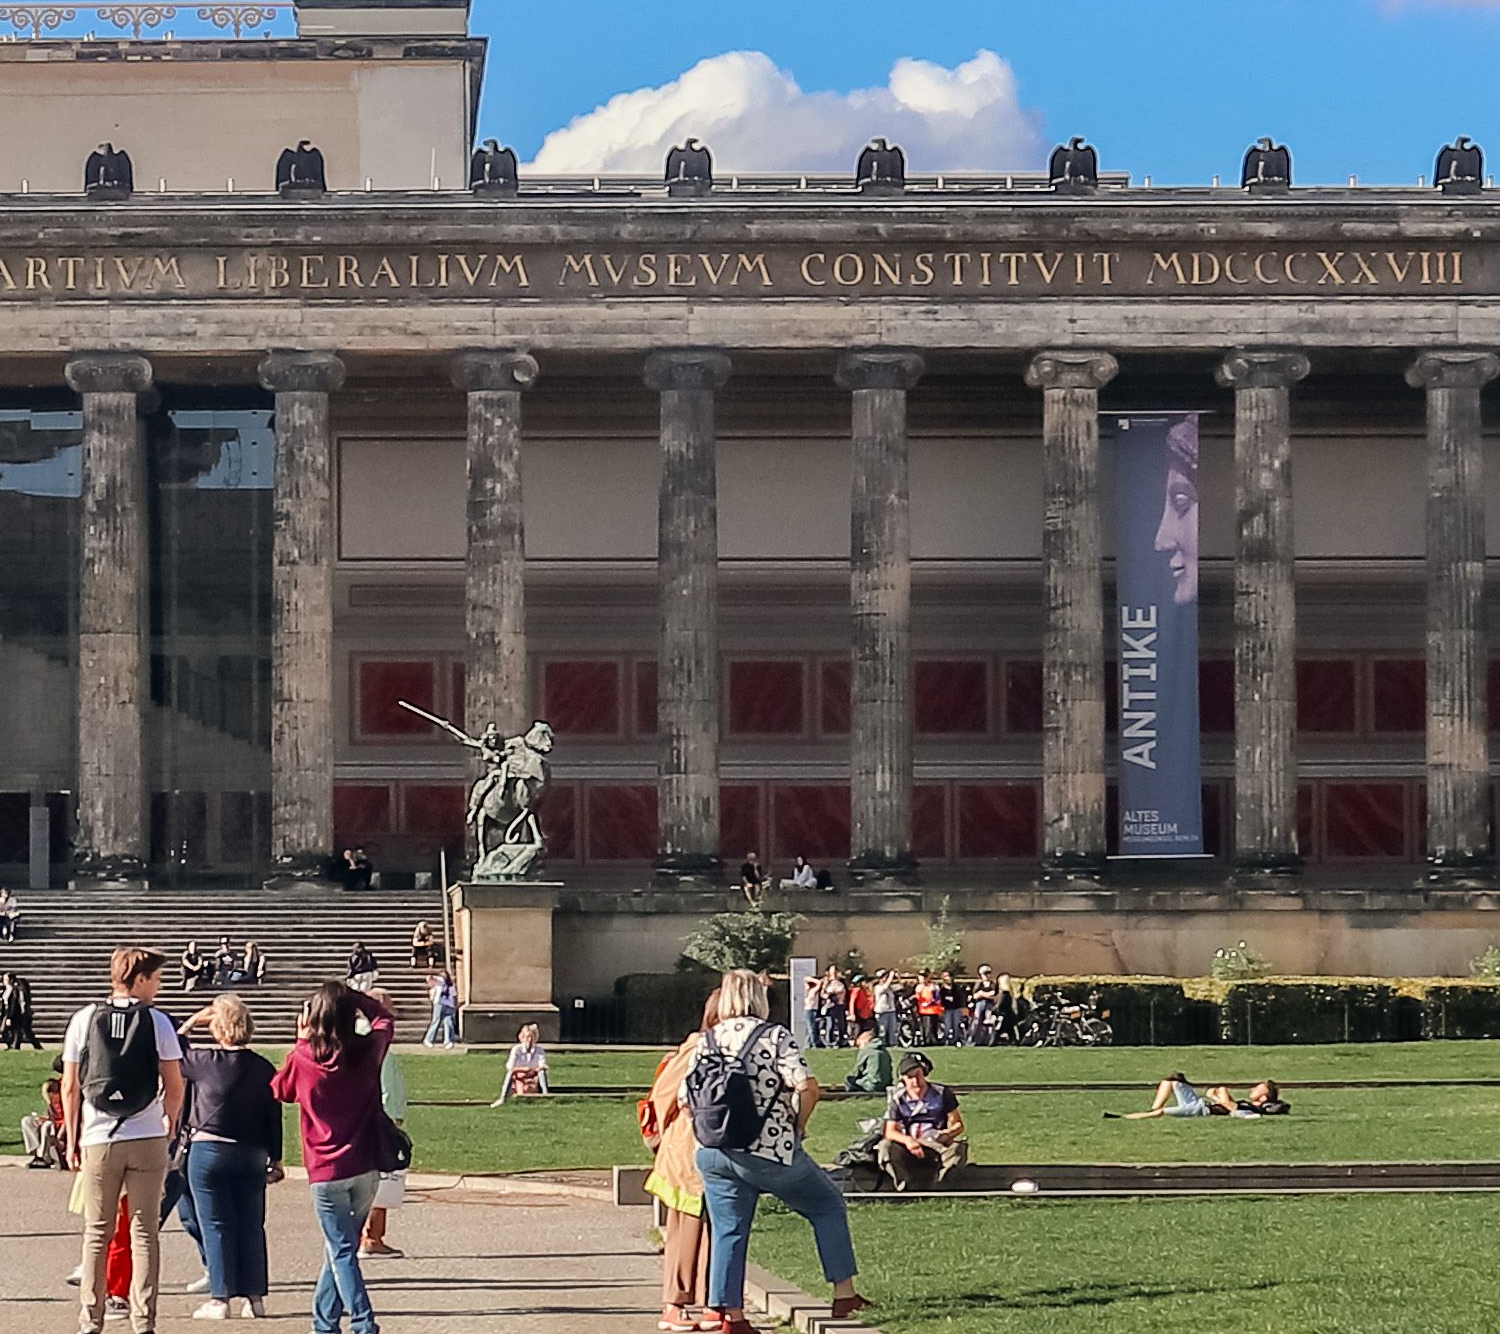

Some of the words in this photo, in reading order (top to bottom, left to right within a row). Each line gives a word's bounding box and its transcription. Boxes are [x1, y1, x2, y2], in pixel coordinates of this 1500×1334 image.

[215, 253, 531, 290] LIBERALIVM
[558, 252, 774, 287] MVSEVM
[801, 251, 1121, 287] CONSTITVIT
[1145, 251, 1463, 286] MDCCCXXVIII
[1122, 604, 1158, 770] ANTIKE
[1123, 810, 1160, 823] ALTES
[1123, 822, 1179, 835] MUSEUM
